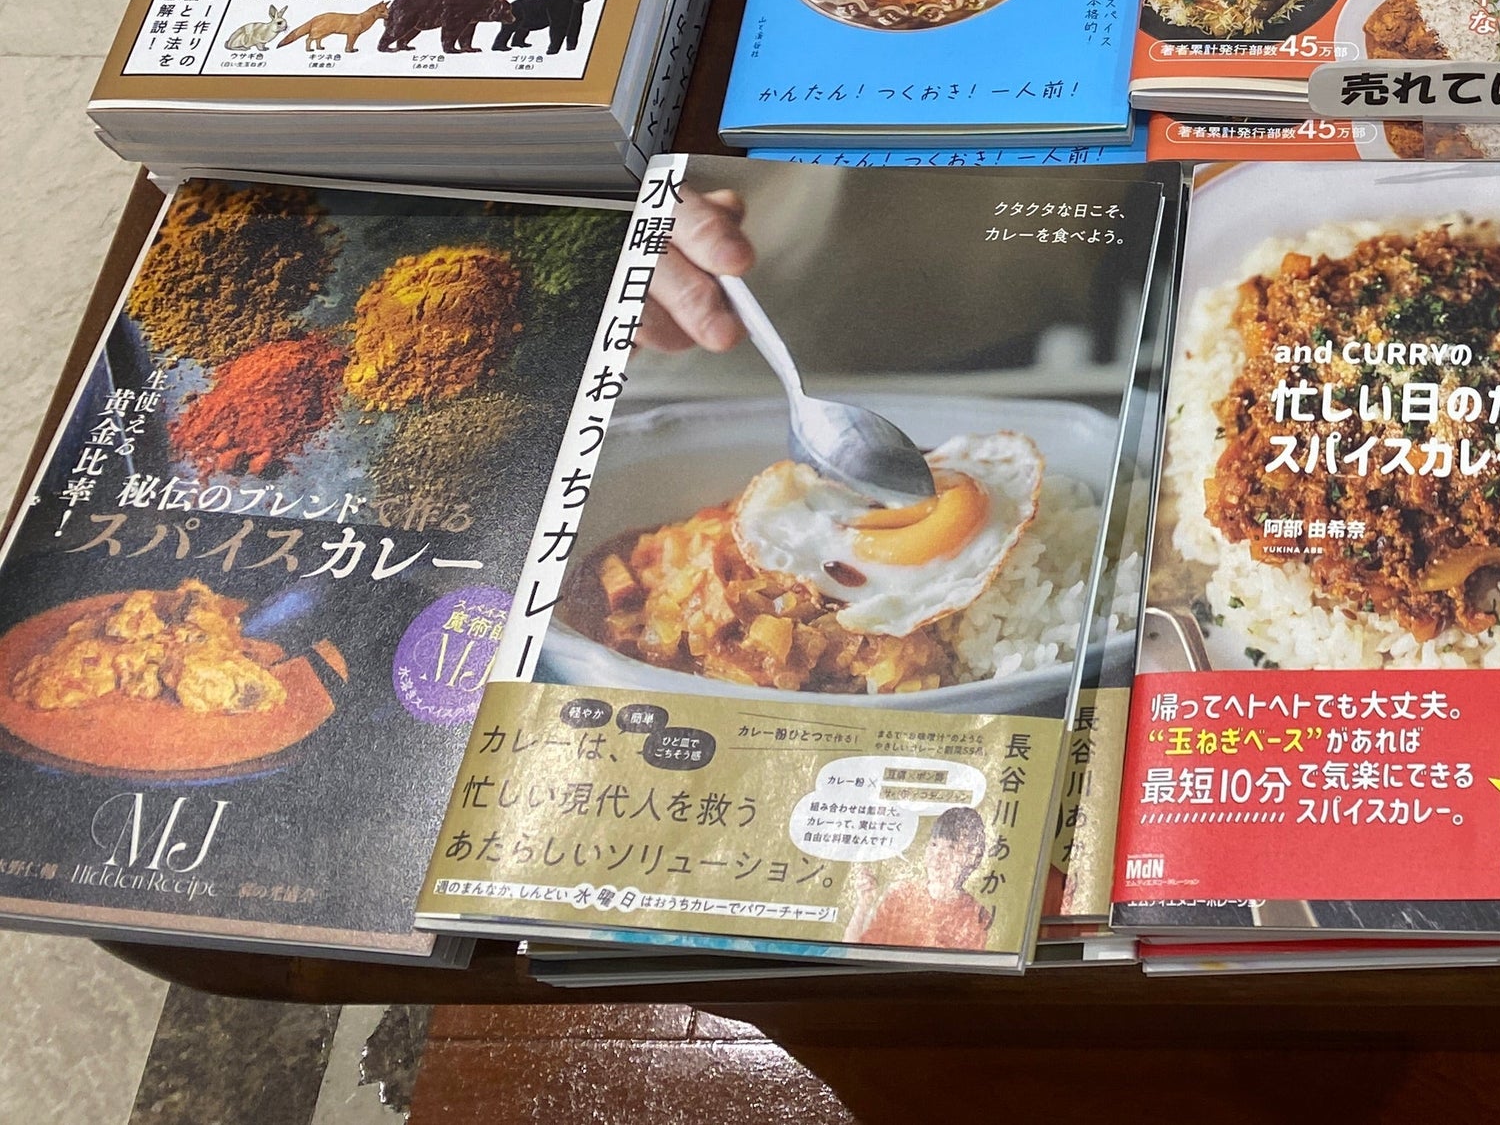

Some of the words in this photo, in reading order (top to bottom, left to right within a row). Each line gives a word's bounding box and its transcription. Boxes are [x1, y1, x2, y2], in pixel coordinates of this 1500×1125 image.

[758, 82, 864, 103] かんたん!
[877, 83, 976, 100] つくおき!
[994, 200, 1127, 220] クタクタな日こそ、
[984, 226, 1127, 247] カレーを食べよう。
[1274, 340, 1332, 365] and
[1342, 342, 1472, 367] CURRYの
[518, 168, 685, 679] 水曜日はおうちカレー
[1263, 518, 1303, 537] 阿部
[1307, 519, 1366, 538] 由希奈
[65, 511, 484, 583] スパイスカレー
[1150, 689, 1462, 723] 帰ってヘトヘトでも大丈夫。
[1140, 766, 1292, 806] 最短10分
[1299, 760, 1476, 789] で気楽にできる
[462, 775, 757, 829] 忙しい現代人を救う
[1295, 795, 1466, 827] スパイスカレー。
[1126, 858, 1165, 880] MdN
